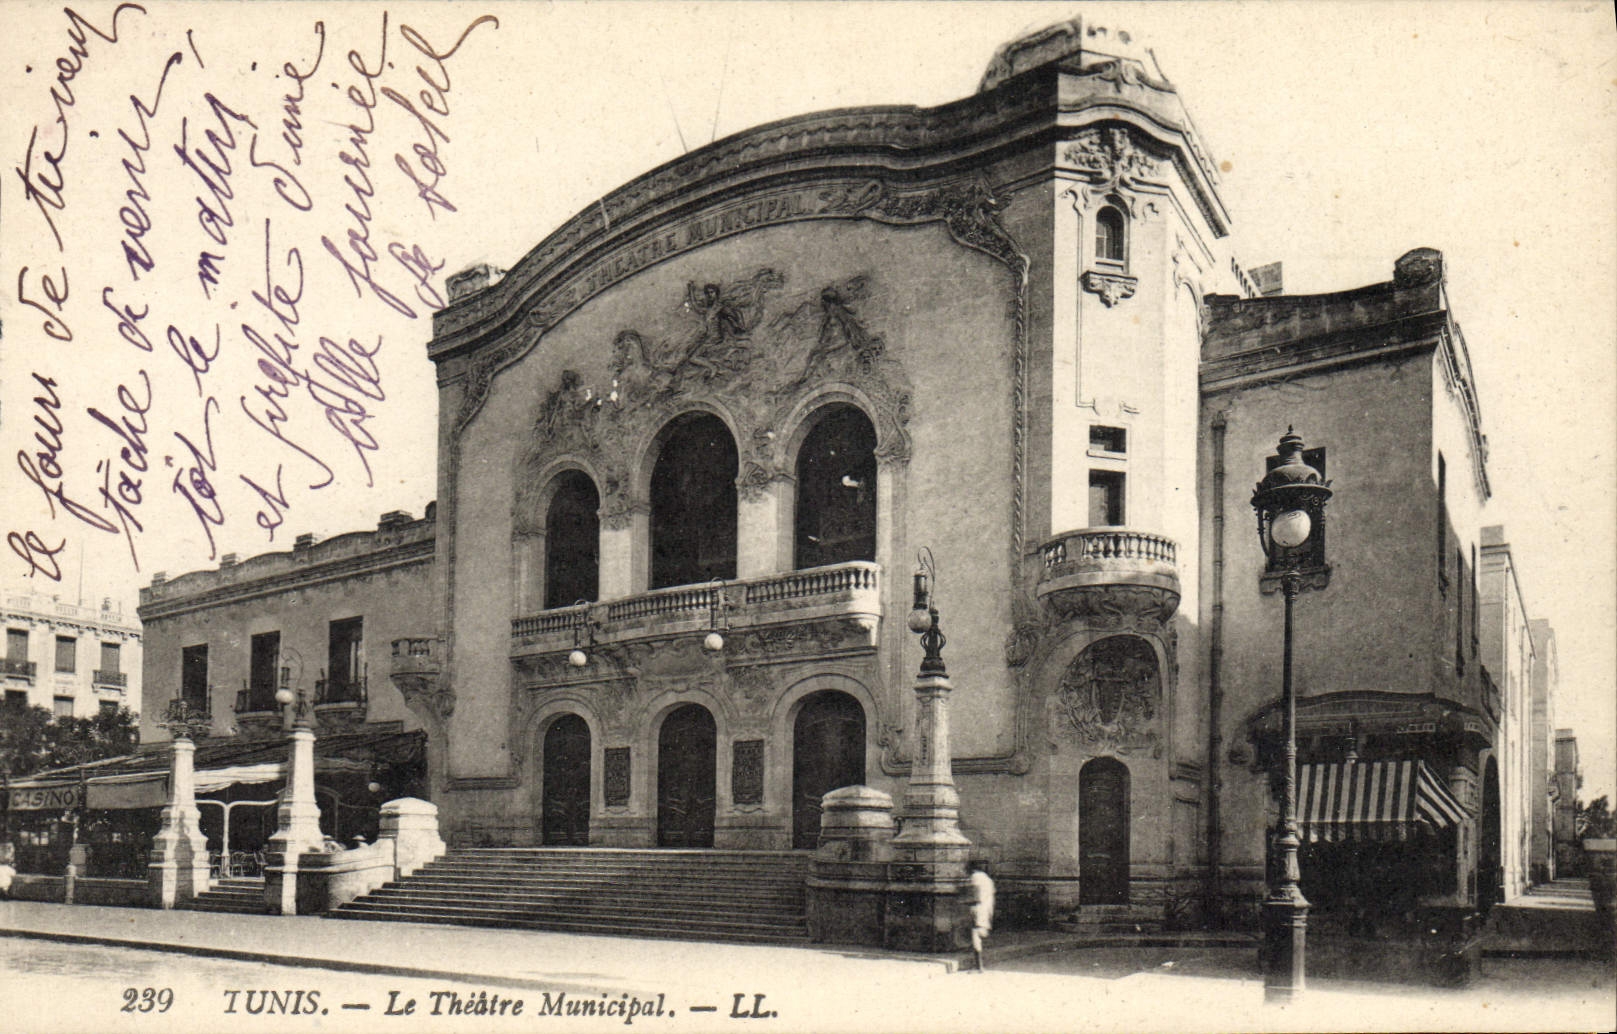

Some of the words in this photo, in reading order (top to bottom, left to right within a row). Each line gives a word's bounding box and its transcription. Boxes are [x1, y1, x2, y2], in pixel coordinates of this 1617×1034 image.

[167, 323, 219, 397] le
[240, 464, 290, 542] et
[12, 789, 75, 808] CASINO
